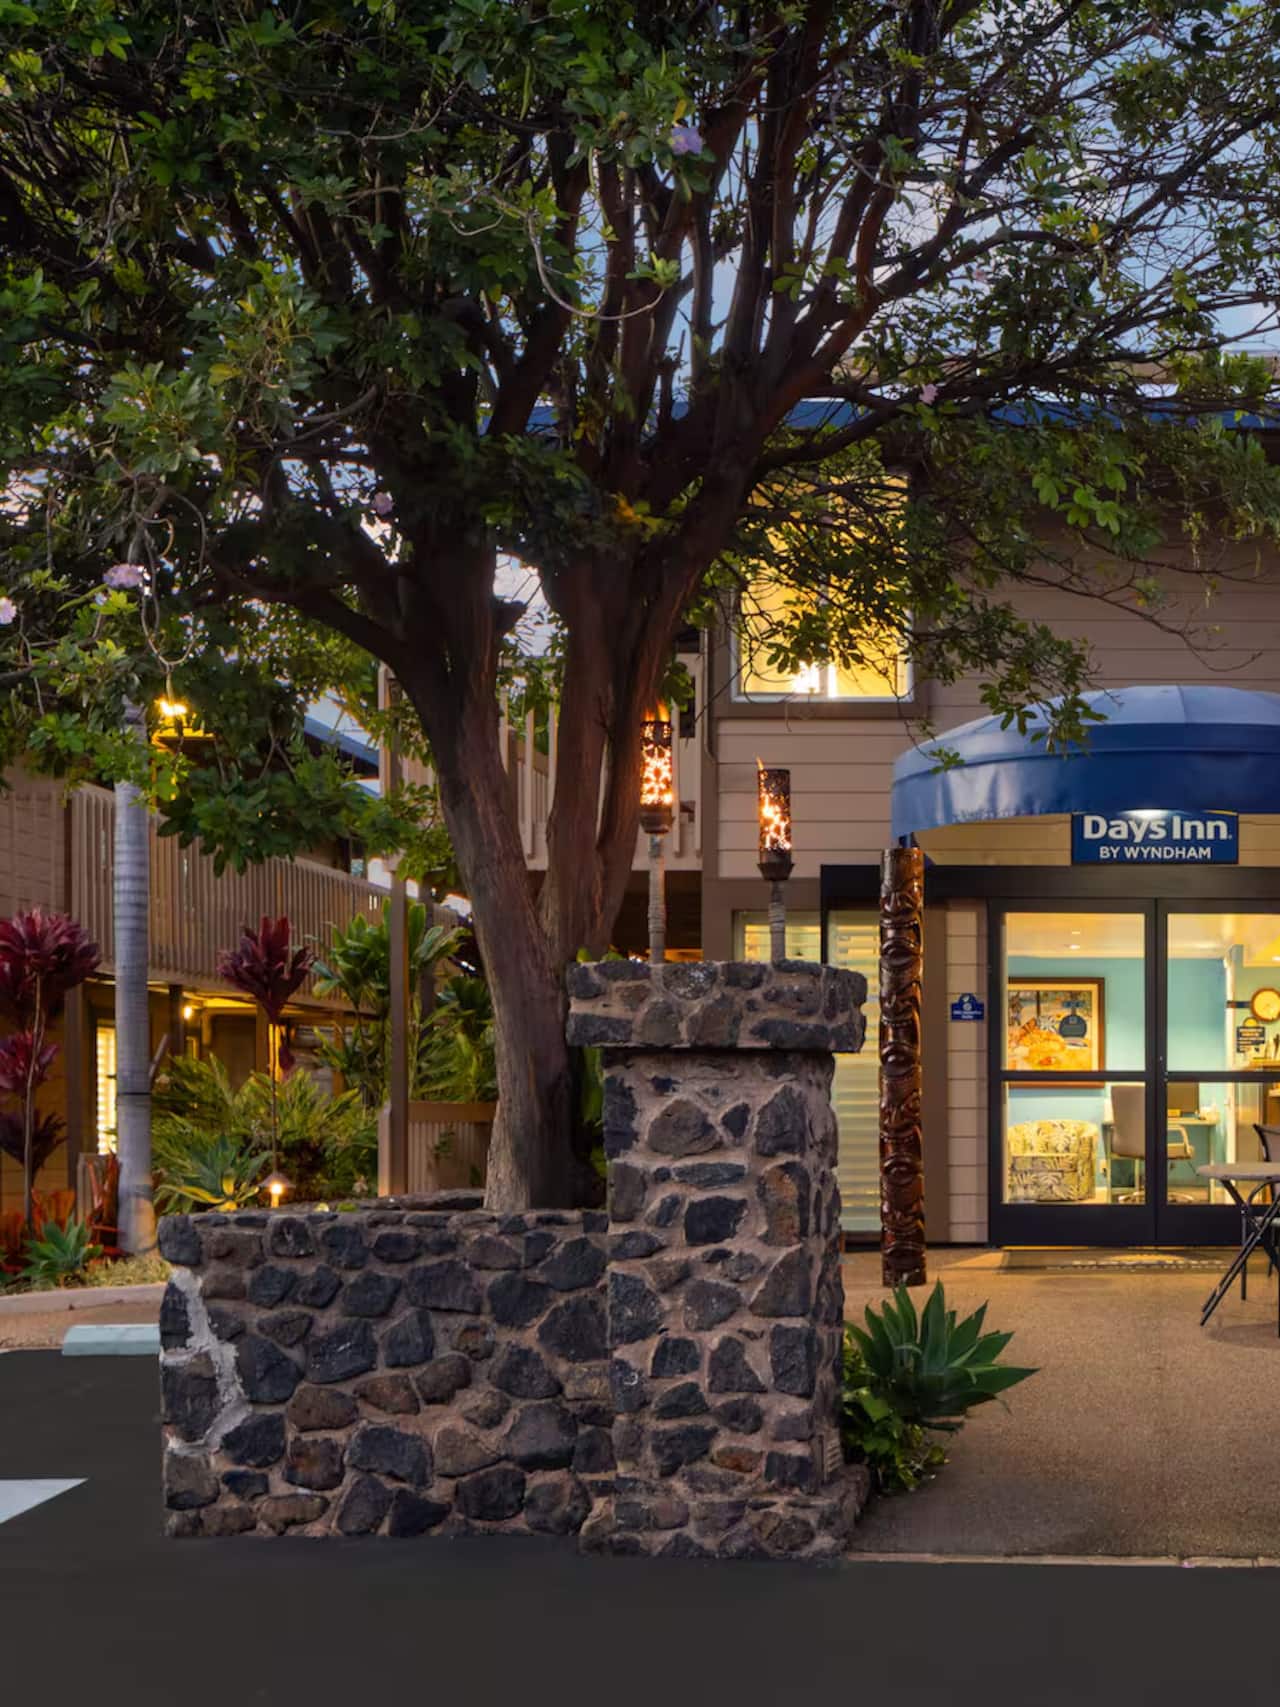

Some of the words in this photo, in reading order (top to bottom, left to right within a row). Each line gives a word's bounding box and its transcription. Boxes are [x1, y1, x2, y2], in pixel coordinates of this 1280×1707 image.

[1084, 816, 1168, 843] Days
[1172, 816, 1228, 840] Inn
[1100, 846, 1120, 859] BY
[1124, 846, 1212, 859] WYNDHAM
